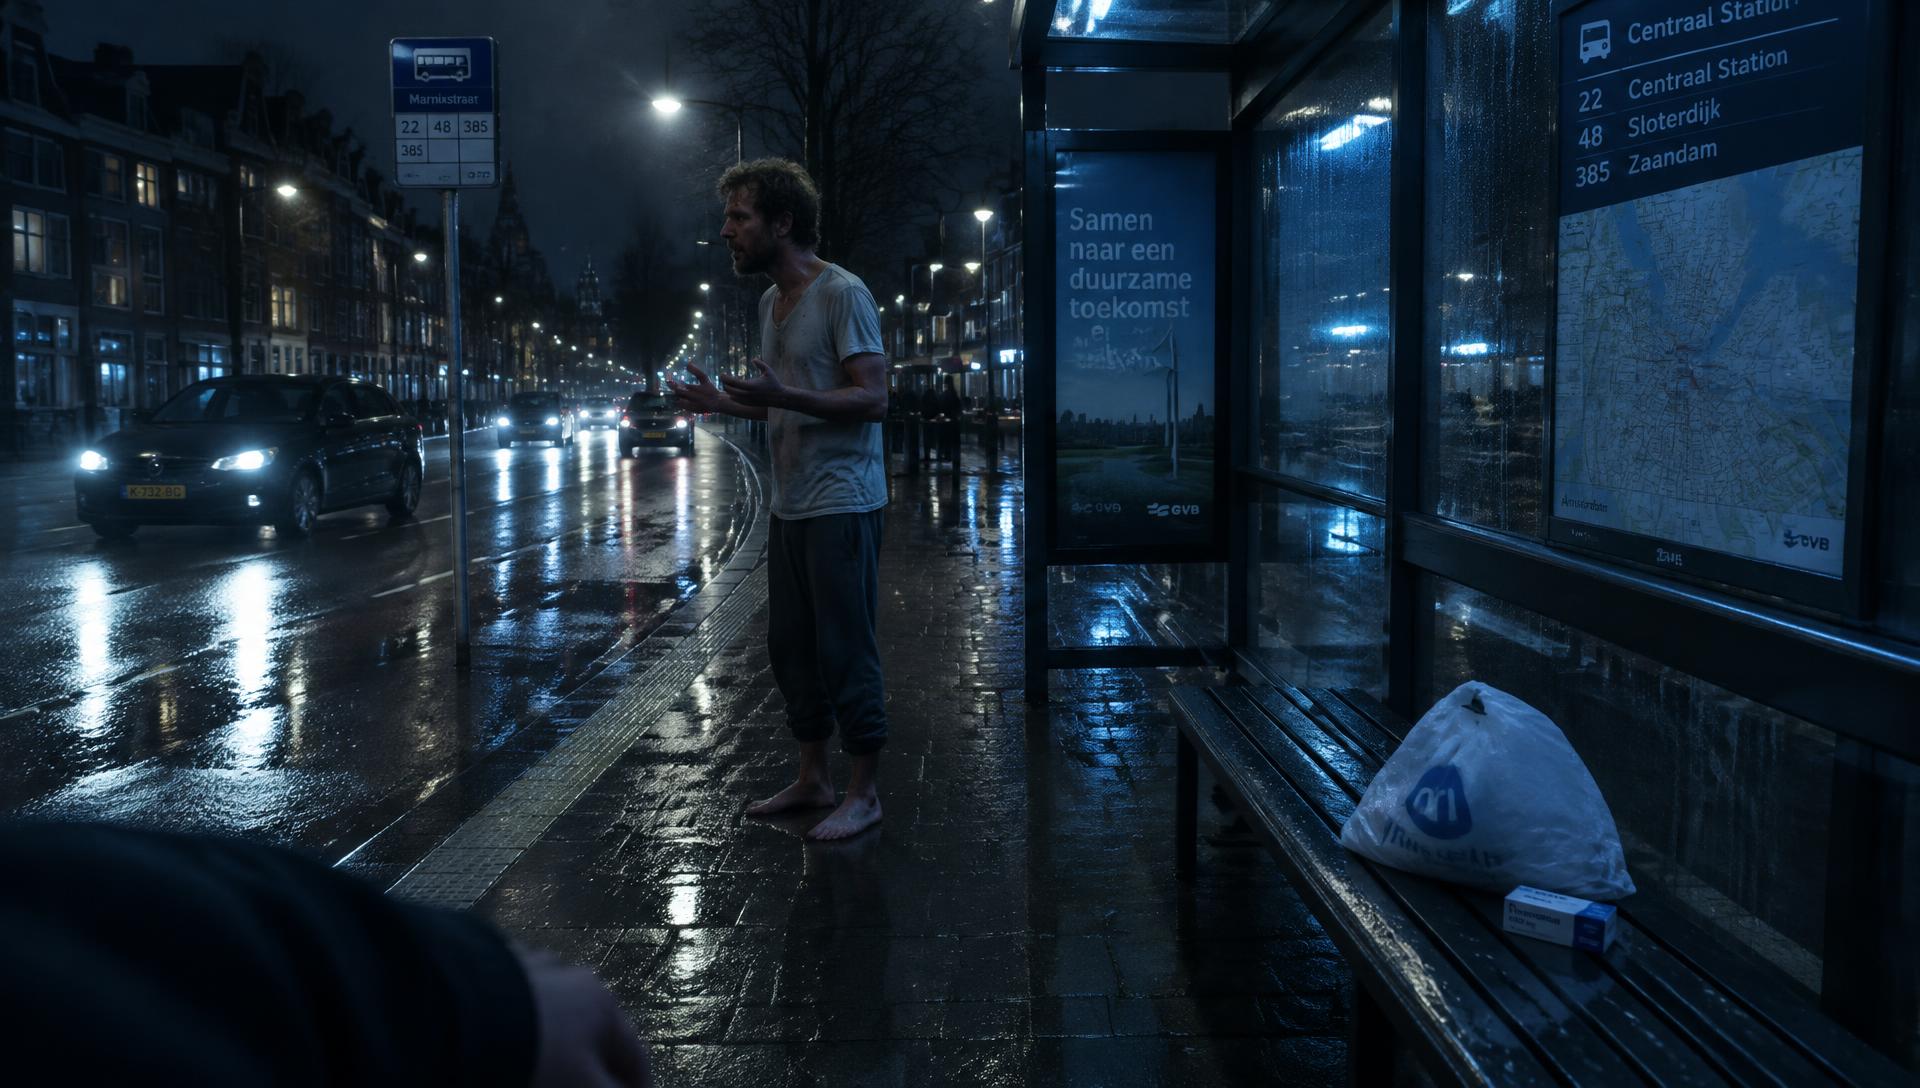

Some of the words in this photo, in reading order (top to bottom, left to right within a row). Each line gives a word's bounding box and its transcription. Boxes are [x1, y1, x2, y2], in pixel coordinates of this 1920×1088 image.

[1628, 7, 1713, 44] Centraal
[1578, 88, 1603, 113] 22
[1628, 61, 1712, 100] Centraal
[1718, 48, 1788, 80] Station
[408, 93, 479, 105] Marnixstraat
[401, 120, 420, 134] 22
[433, 120, 451, 133] 48
[463, 120, 488, 133] 385
[1578, 125, 1604, 150] 48
[1627, 97, 1721, 138] Sloterdijk
[401, 144, 423, 157] 385
[1575, 160, 1611, 188] 385
[1627, 141, 1718, 176] Zaandam
[1069, 207, 1153, 231] Samen
[1069, 241, 1126, 261] naar
[1130, 242, 1175, 261] een
[1069, 267, 1192, 290] duurzame
[1069, 295, 1190, 319] toekomst
[1171, 504, 1200, 516] GVB
